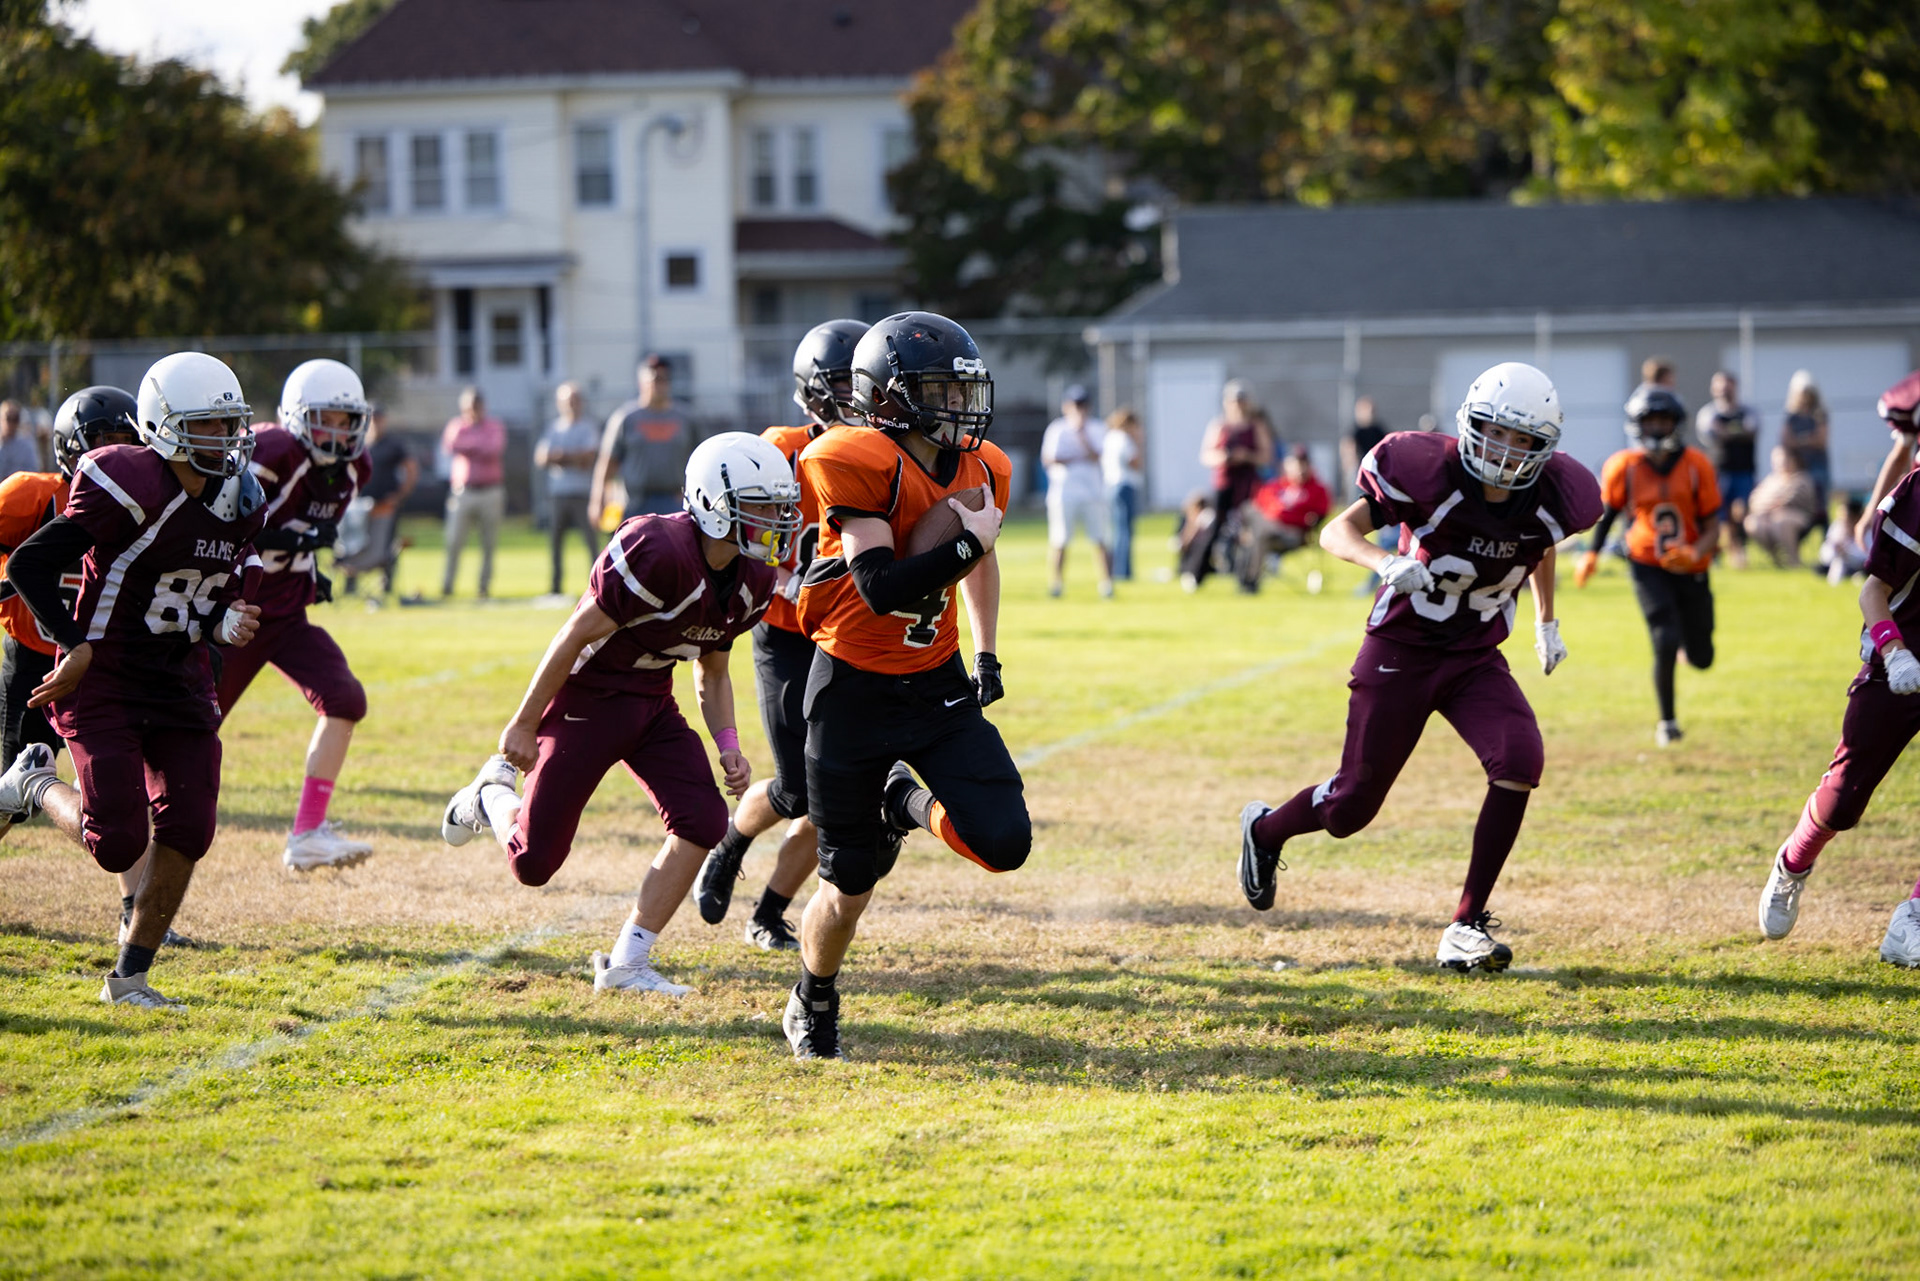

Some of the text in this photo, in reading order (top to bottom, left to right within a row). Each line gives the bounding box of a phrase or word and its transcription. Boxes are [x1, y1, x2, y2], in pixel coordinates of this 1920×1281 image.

[193, 539, 234, 562] RAMS
[1467, 535, 1518, 559] RAMS
[1651, 502, 1686, 560] 2
[1409, 553, 1527, 623] 34
